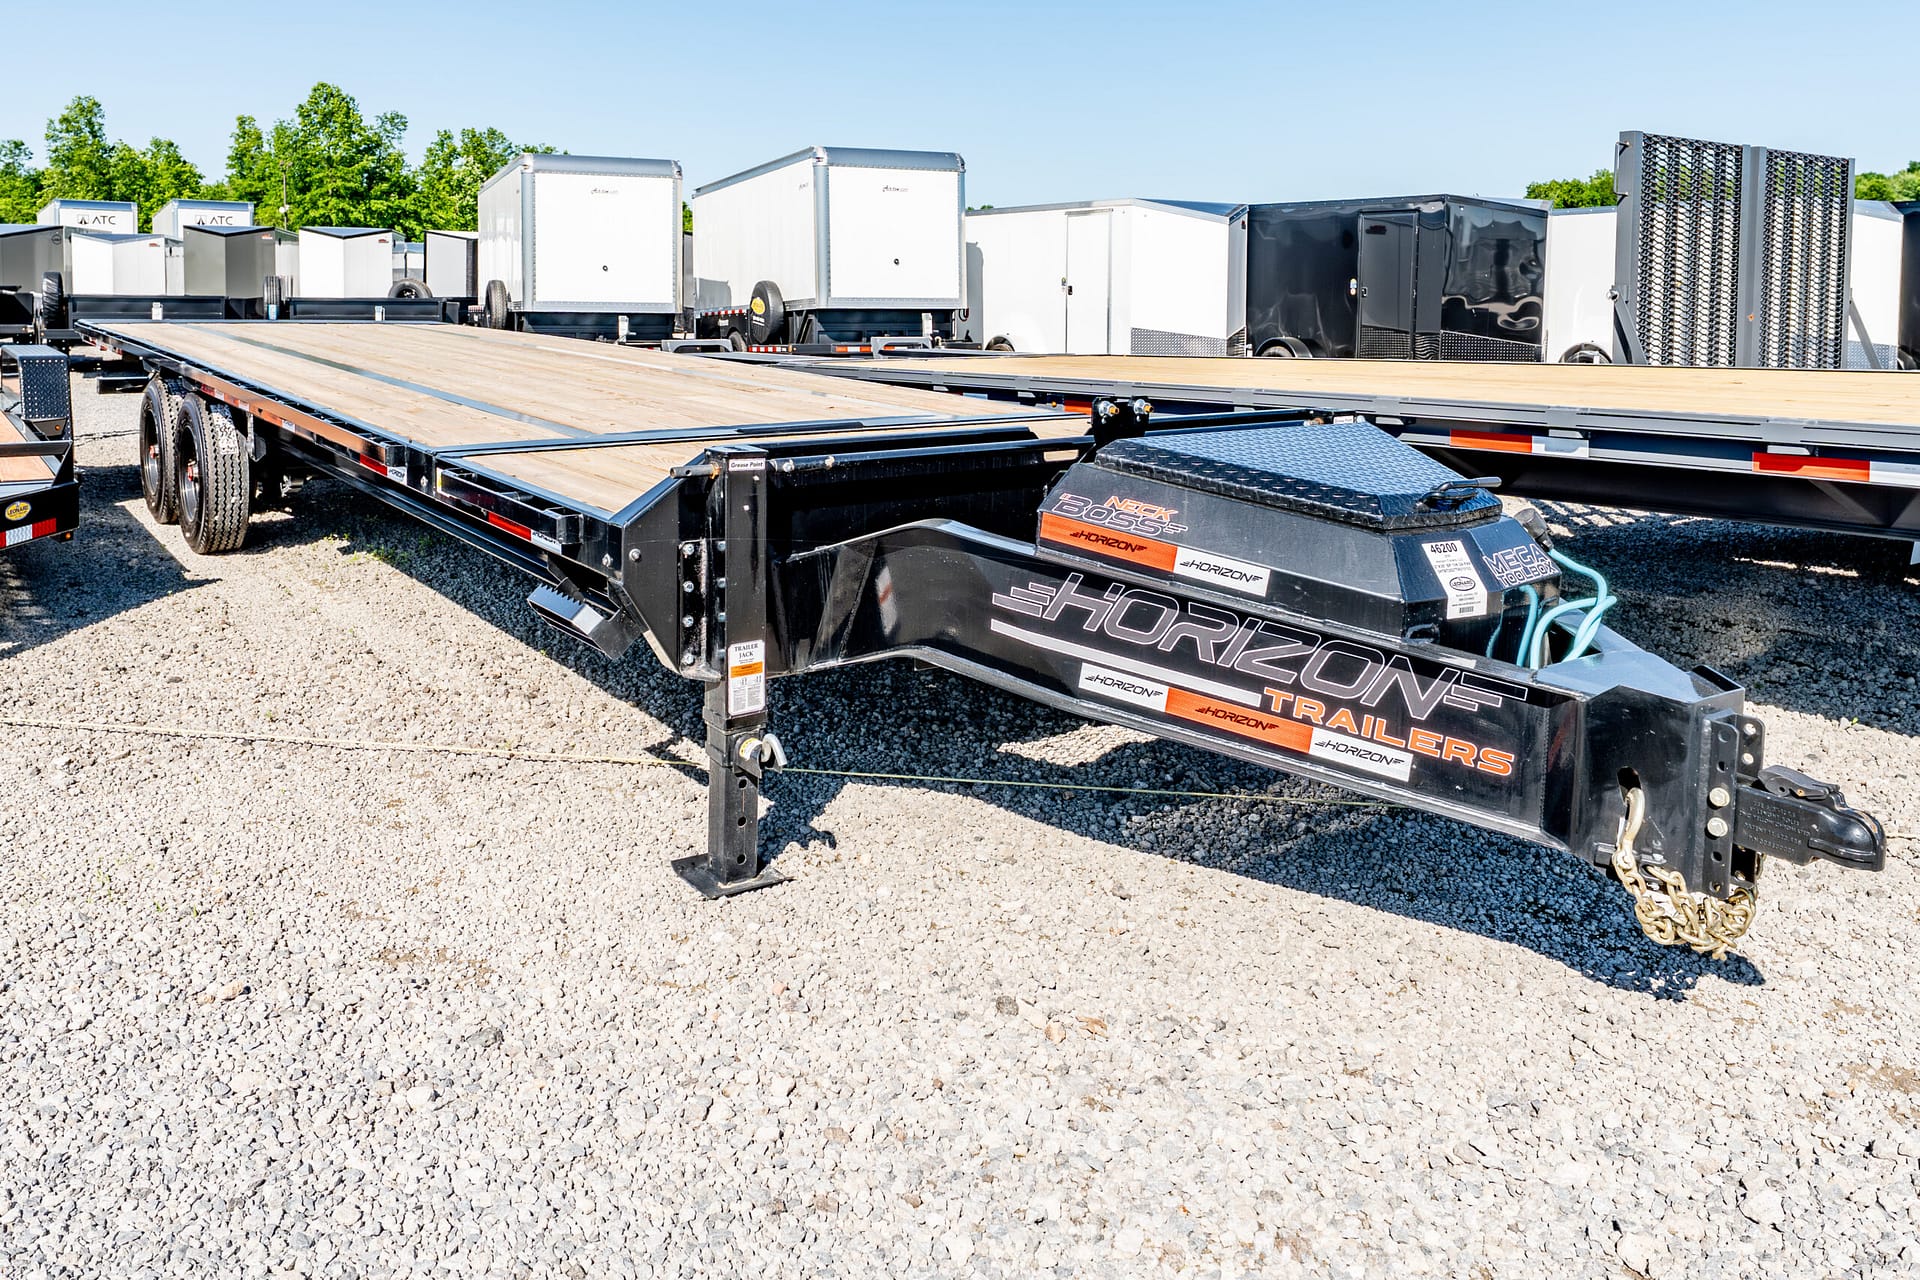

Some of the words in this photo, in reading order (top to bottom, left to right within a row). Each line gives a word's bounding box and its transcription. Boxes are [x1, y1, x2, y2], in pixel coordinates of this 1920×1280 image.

[92, 215, 116, 225] ATC
[210, 215, 233, 225] ATC
[1051, 494, 1167, 536] BOSS
[1104, 496, 1178, 521] NECK
[1077, 530, 1140, 553] HORIZON
[1430, 542, 1458, 554] 46200
[1188, 559, 1256, 583] HORIZON
[1482, 543, 1549, 576] MEGA
[1498, 561, 1559, 588] TOOLBOX
[734, 643, 758, 652] TRAILER
[739, 651, 753, 659] JACK
[1040, 572, 1460, 721] HORIZON
[1093, 673, 1155, 698] HORIZON
[1203, 705, 1270, 731] HORIZON
[1264, 686, 1515, 776] TRAILERS
[1323, 739, 1396, 766] HORIZON
